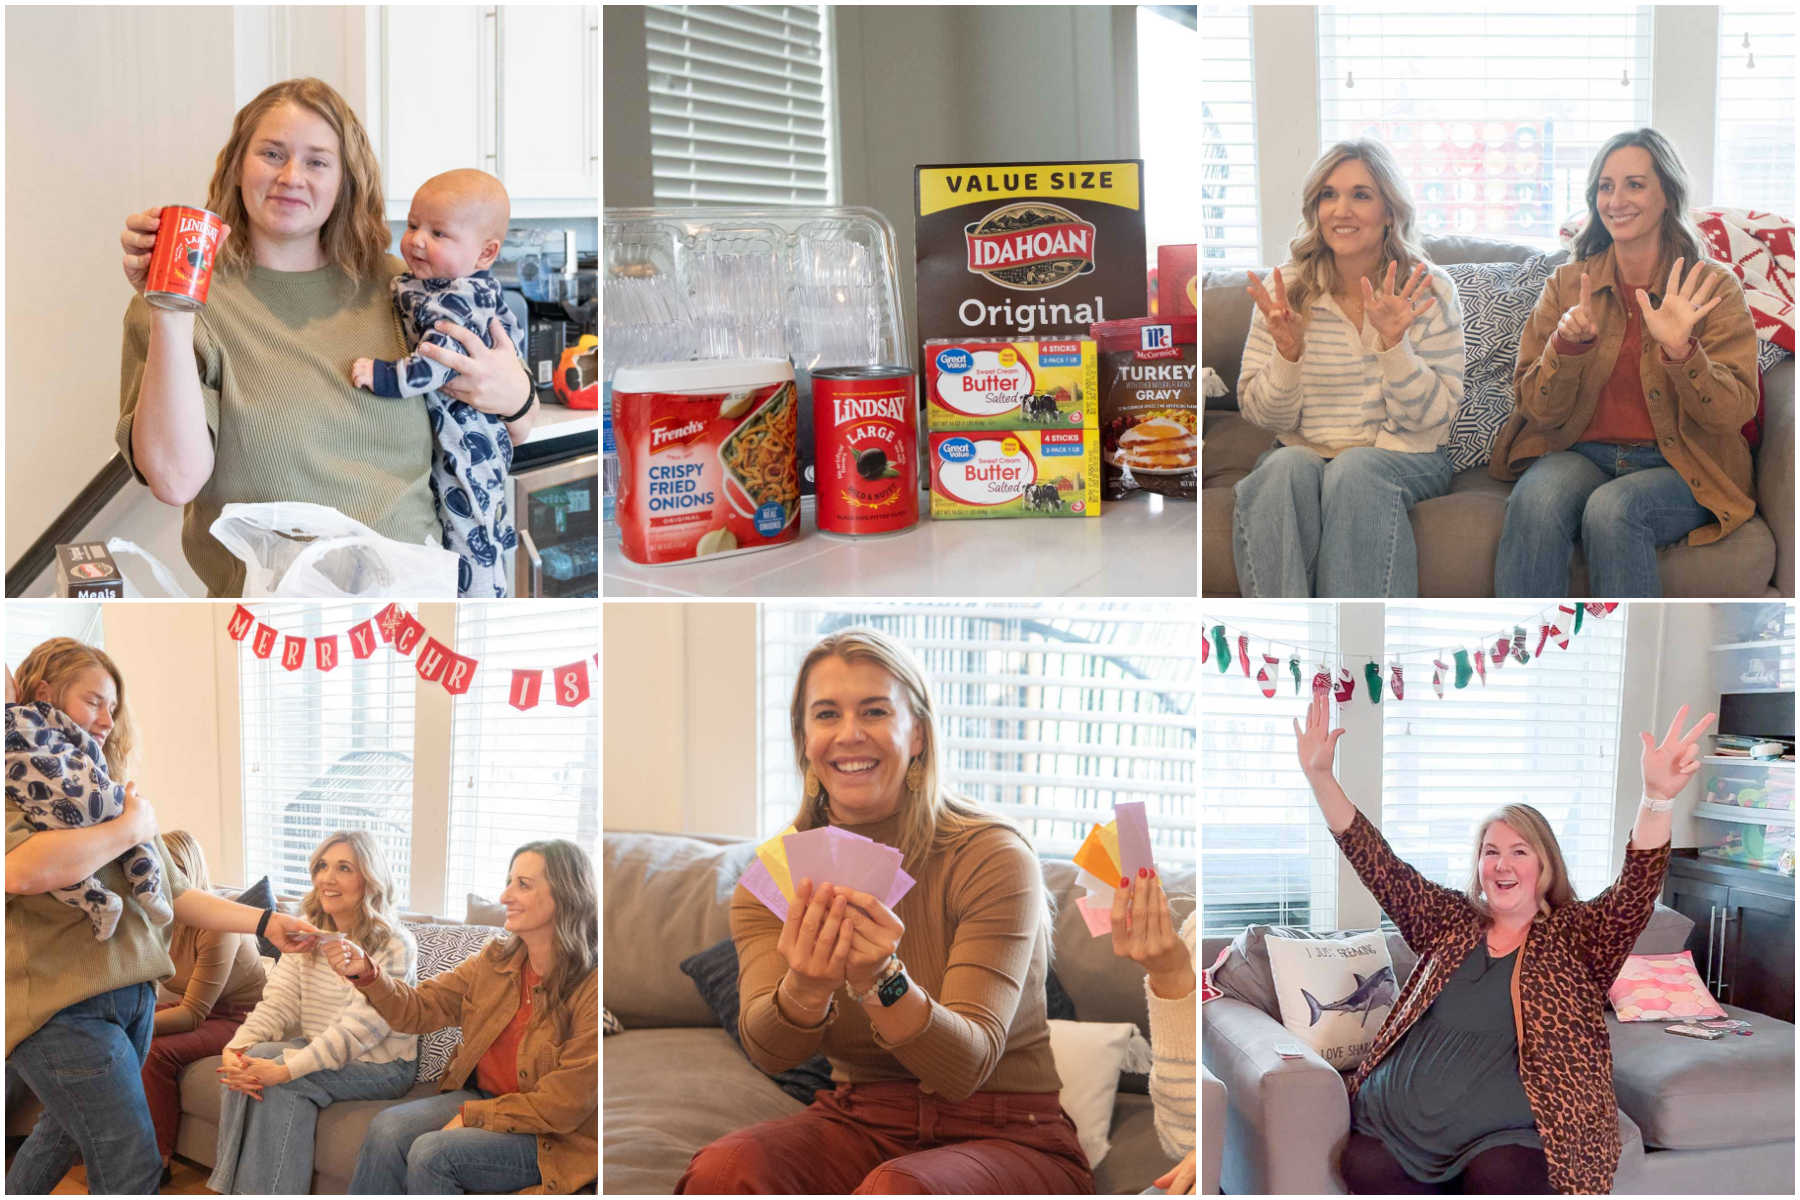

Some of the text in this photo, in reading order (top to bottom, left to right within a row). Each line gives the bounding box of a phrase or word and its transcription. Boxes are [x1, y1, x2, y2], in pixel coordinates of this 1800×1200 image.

[946, 171, 1113, 193] VALUE SIZE
[974, 229, 1087, 266] IDAHOAN
[959, 296, 1105, 332] Original
[940, 354, 966, 363] Great
[946, 360, 967, 369] Value
[1118, 364, 1196, 381] TURKEY
[962, 375, 1019, 392] Butter
[985, 392, 1020, 404] Salted
[1136, 389, 1181, 400] GRAVY
[652, 420, 704, 446] French's
[846, 426, 896, 445] LARGE
[942, 444, 969, 453] Great
[949, 449, 969, 458] Value
[649, 463, 705, 480] CRISPY
[965, 465, 1021, 481] Butter
[649, 479, 696, 496] FRIED
[988, 482, 1021, 493] Salted
[649, 492, 715, 511] ONIONS
[78, 588, 116, 598] Meals
[1321, 1046, 1343, 1060] LOVE
